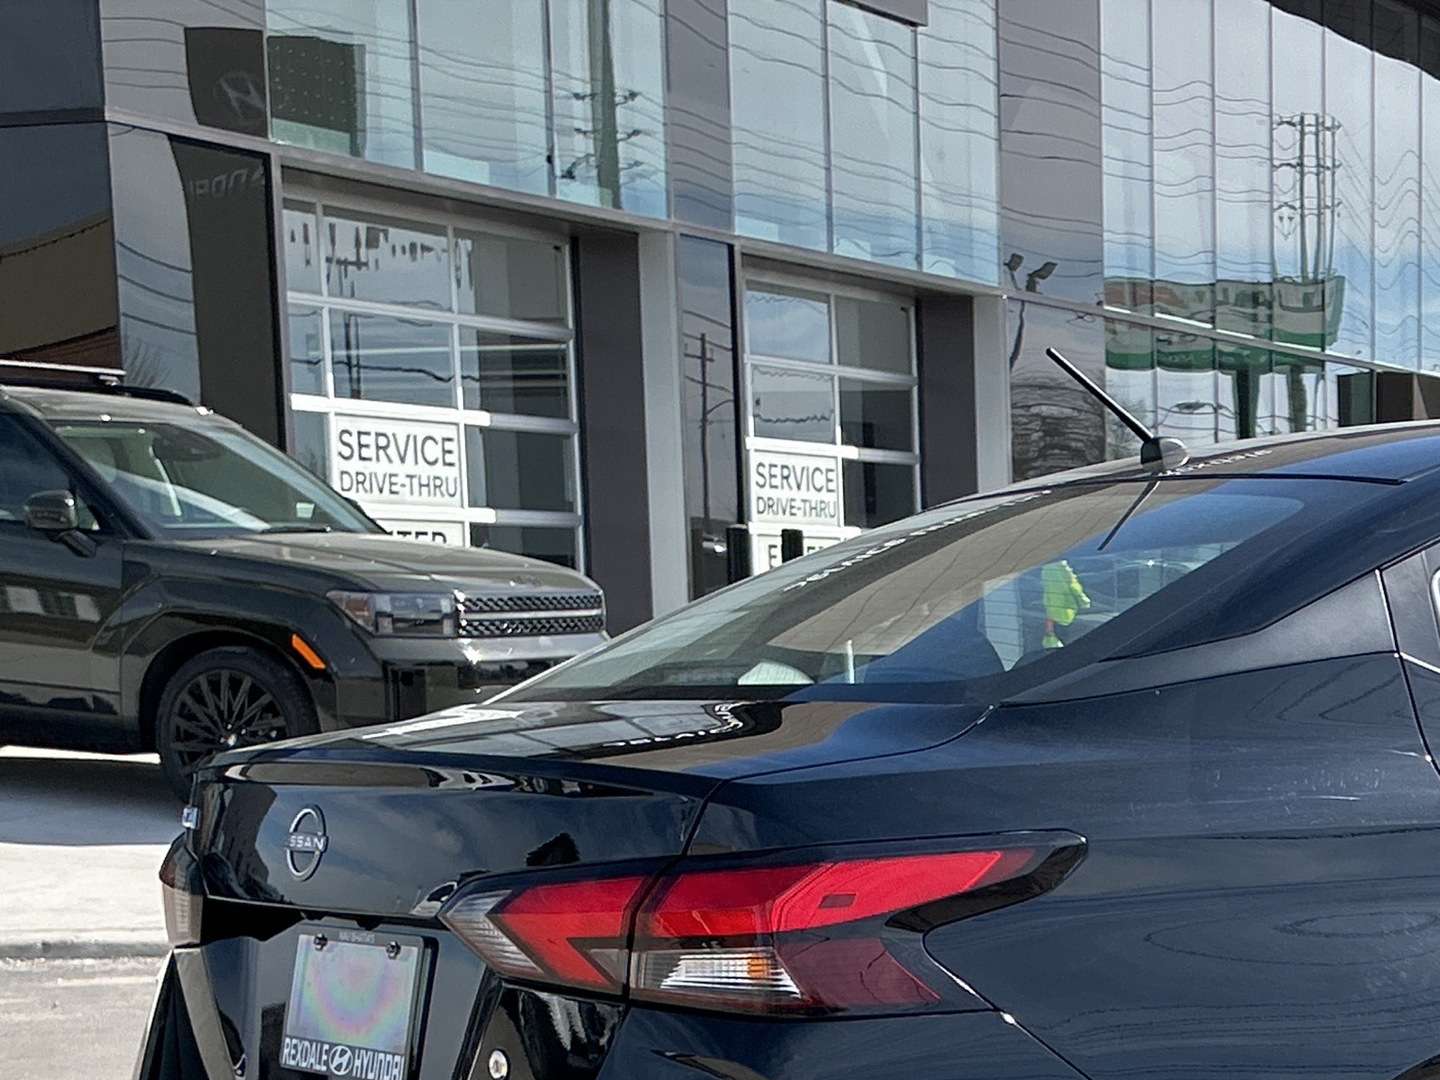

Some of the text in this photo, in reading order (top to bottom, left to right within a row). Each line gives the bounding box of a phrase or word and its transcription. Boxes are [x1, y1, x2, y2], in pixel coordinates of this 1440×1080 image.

[338, 429, 456, 467] SERVICE
[340, 470, 457, 498] DRIVE-THRU
[755, 462, 836, 493] SERVICE
[757, 496, 837, 518] DRIVE-THRU
[282, 1037, 329, 1072] REXDALE
